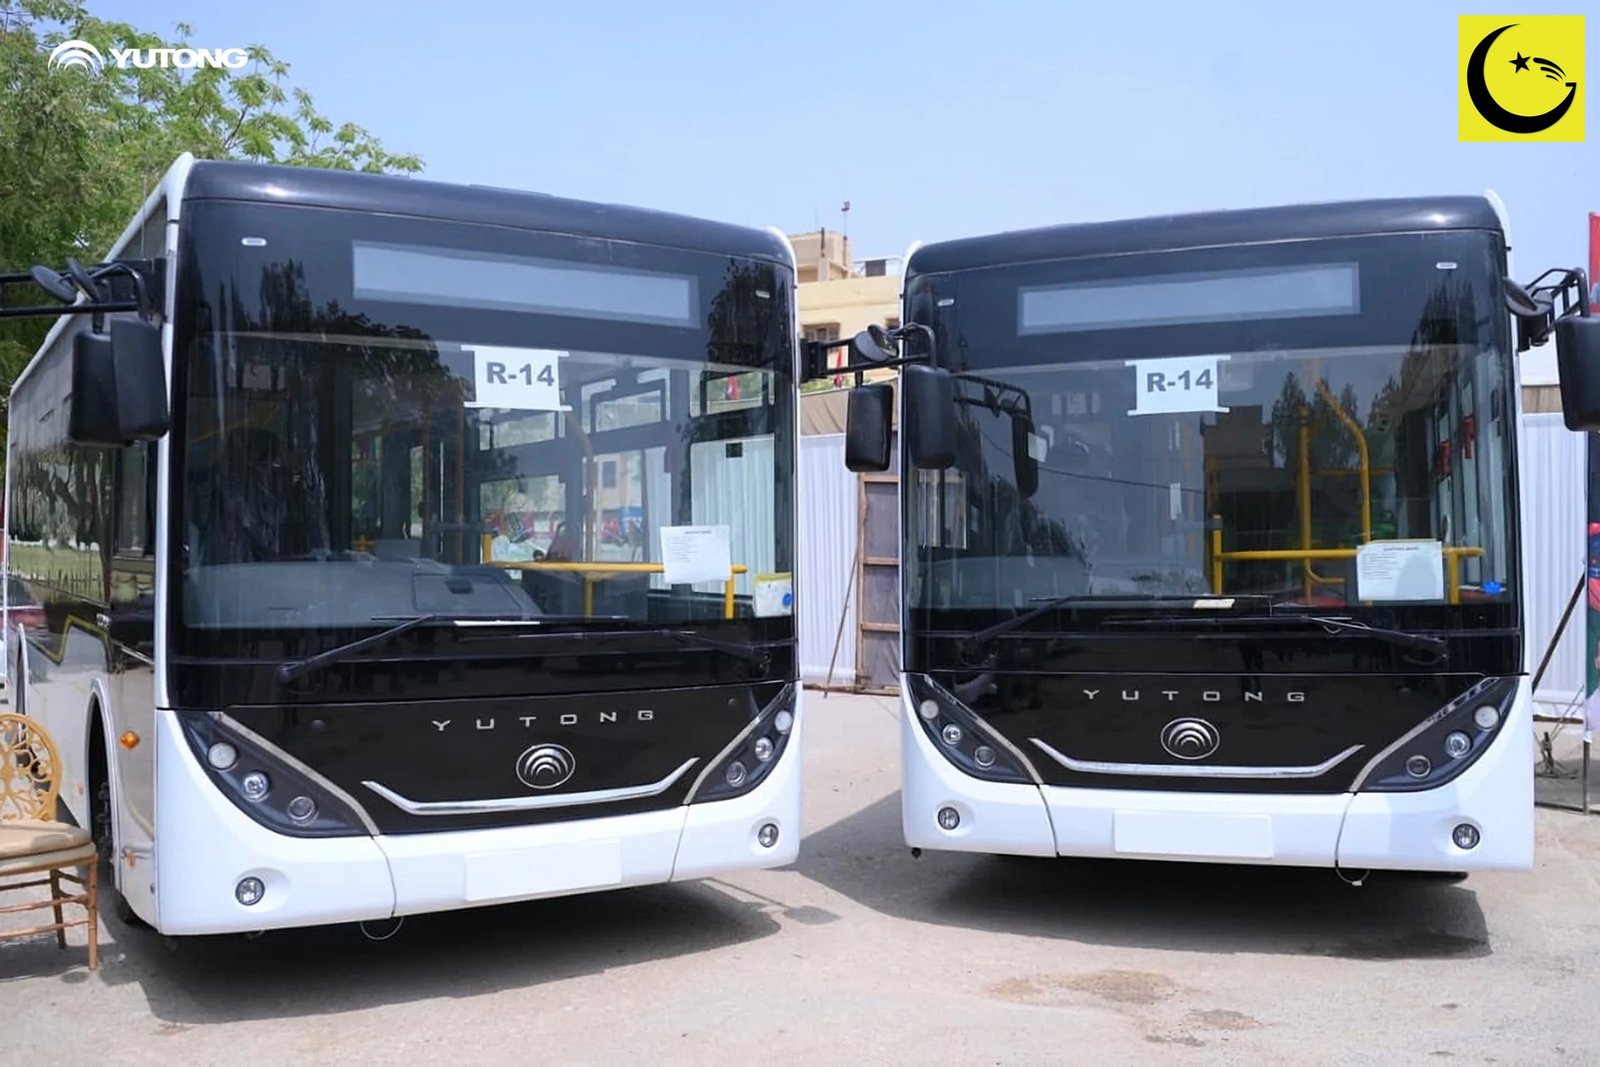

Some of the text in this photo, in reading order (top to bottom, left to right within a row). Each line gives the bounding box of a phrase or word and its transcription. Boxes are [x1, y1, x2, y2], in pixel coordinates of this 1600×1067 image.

[486, 361, 555, 387] R-14
[1146, 368, 1213, 393] R-14
[1083, 689, 1305, 702] YUTONG
[431, 709, 654, 732] YUTONG
